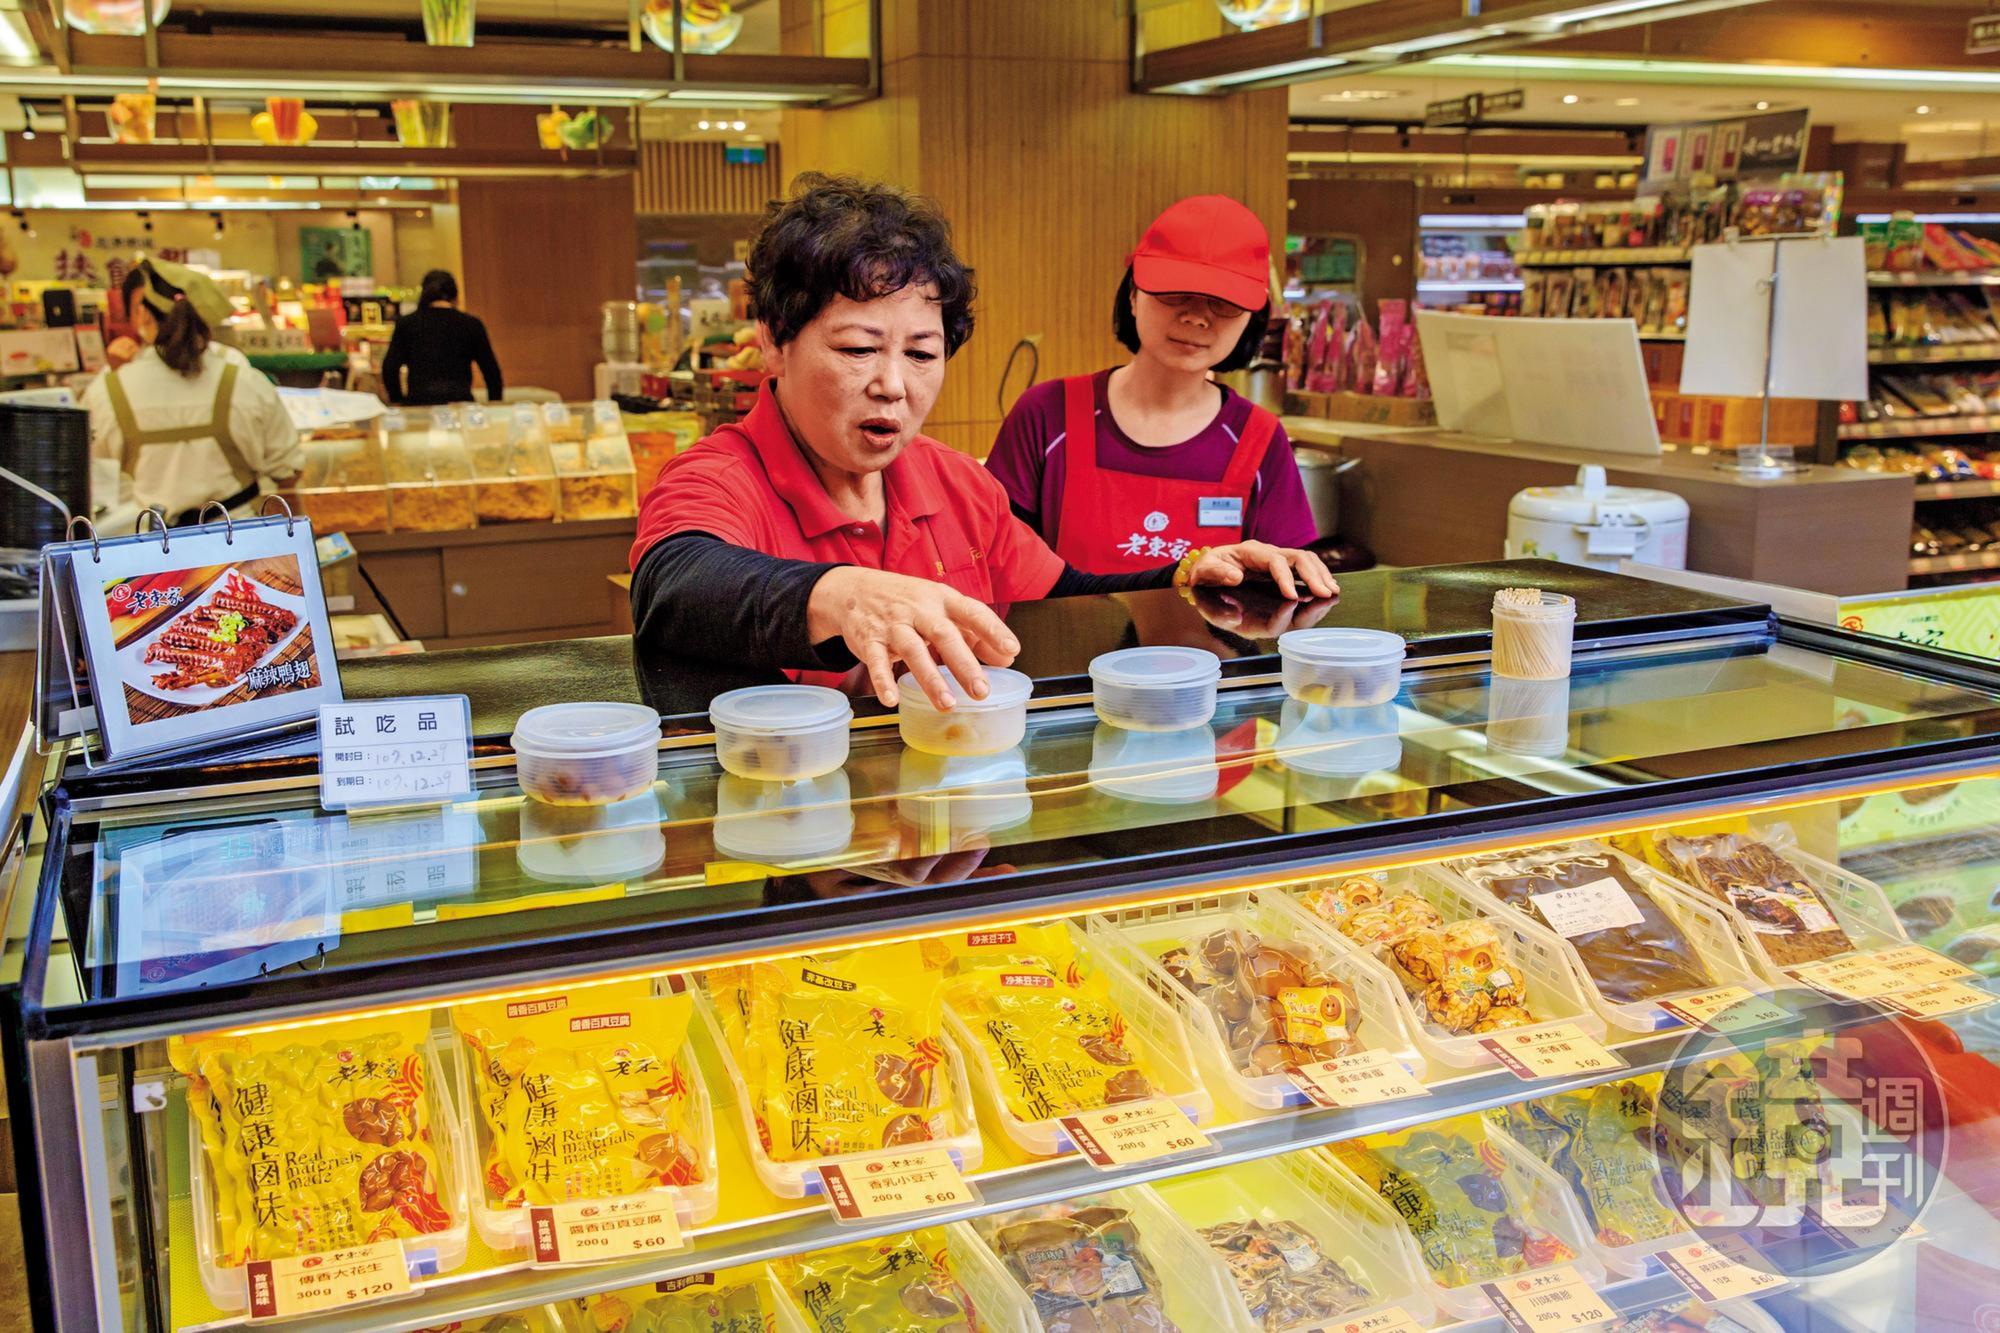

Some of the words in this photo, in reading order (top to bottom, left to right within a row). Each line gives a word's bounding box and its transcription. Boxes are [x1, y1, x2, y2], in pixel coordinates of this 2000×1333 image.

[1117, 533, 1191, 561] 老東家
[126, 587, 184, 615] 老東家
[247, 659, 312, 692] 麻辣鴨翅
[335, 711, 437, 736] 試吃品
